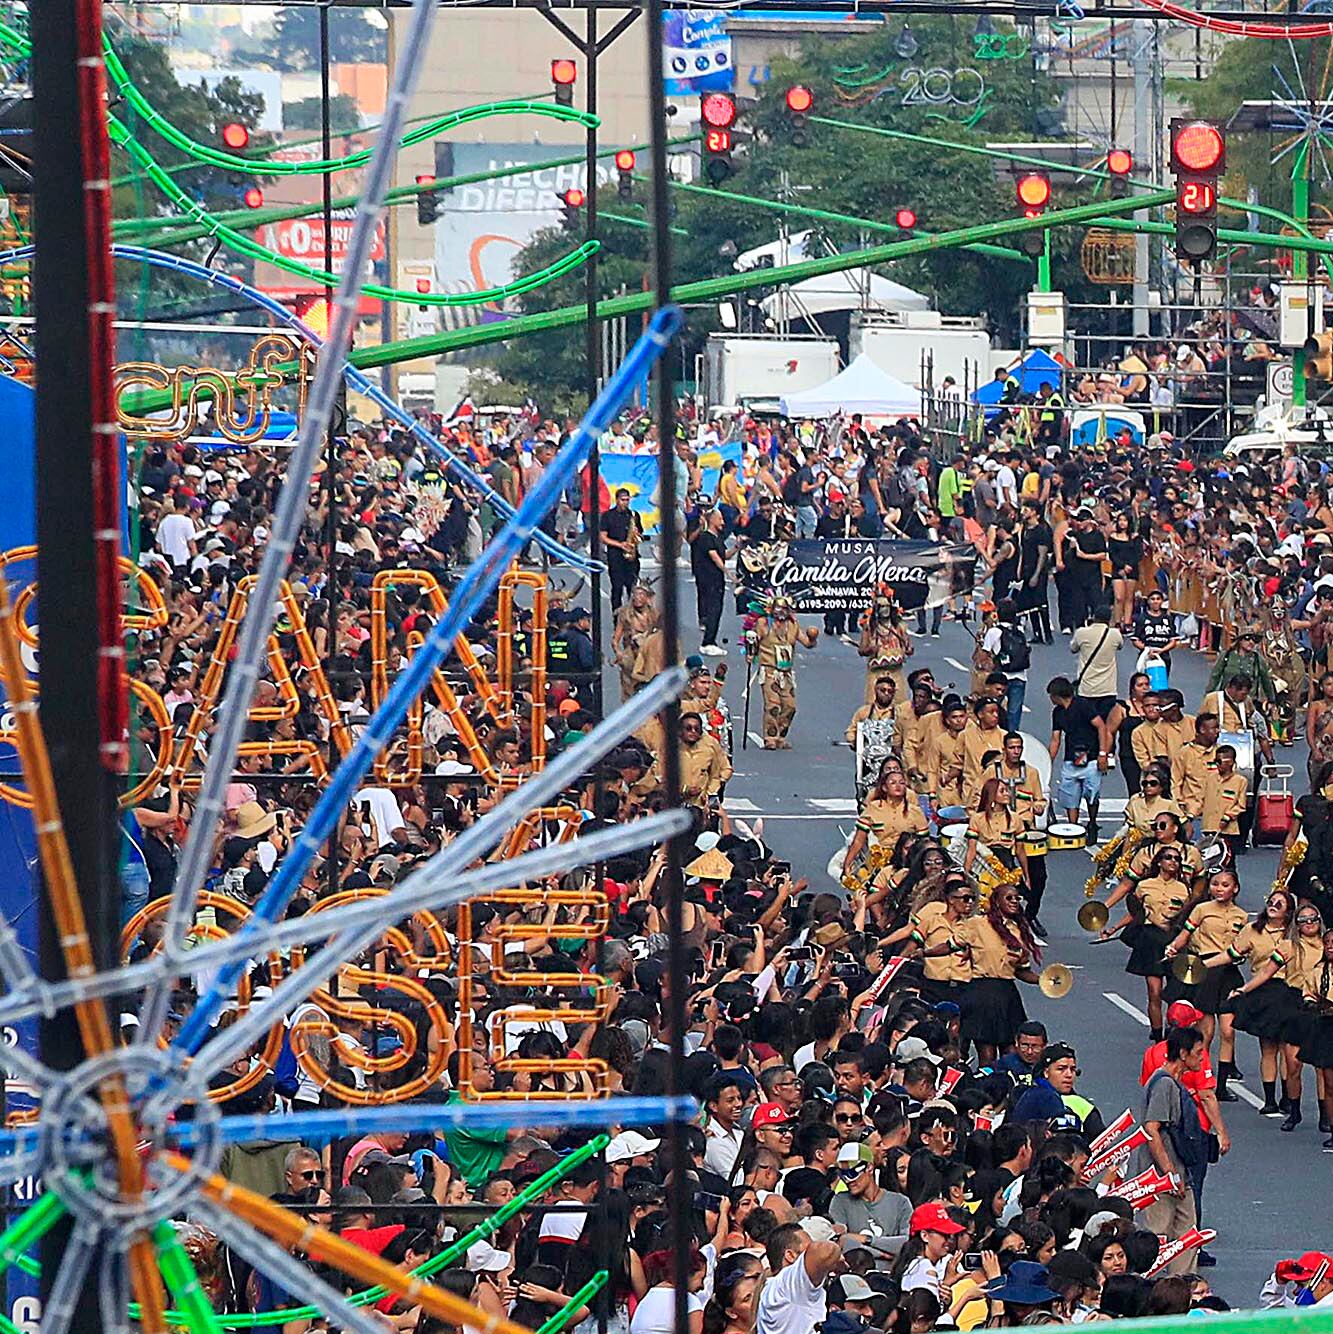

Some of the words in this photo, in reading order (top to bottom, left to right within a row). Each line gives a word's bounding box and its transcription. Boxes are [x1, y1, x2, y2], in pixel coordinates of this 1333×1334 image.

[900, 67, 984, 105] 200
[709, 132, 728, 150] 21
[1183, 185, 1210, 209] 21
[825, 542, 876, 555] MUSA
[770, 556, 852, 587] Camila
[853, 554, 928, 585] Mena
